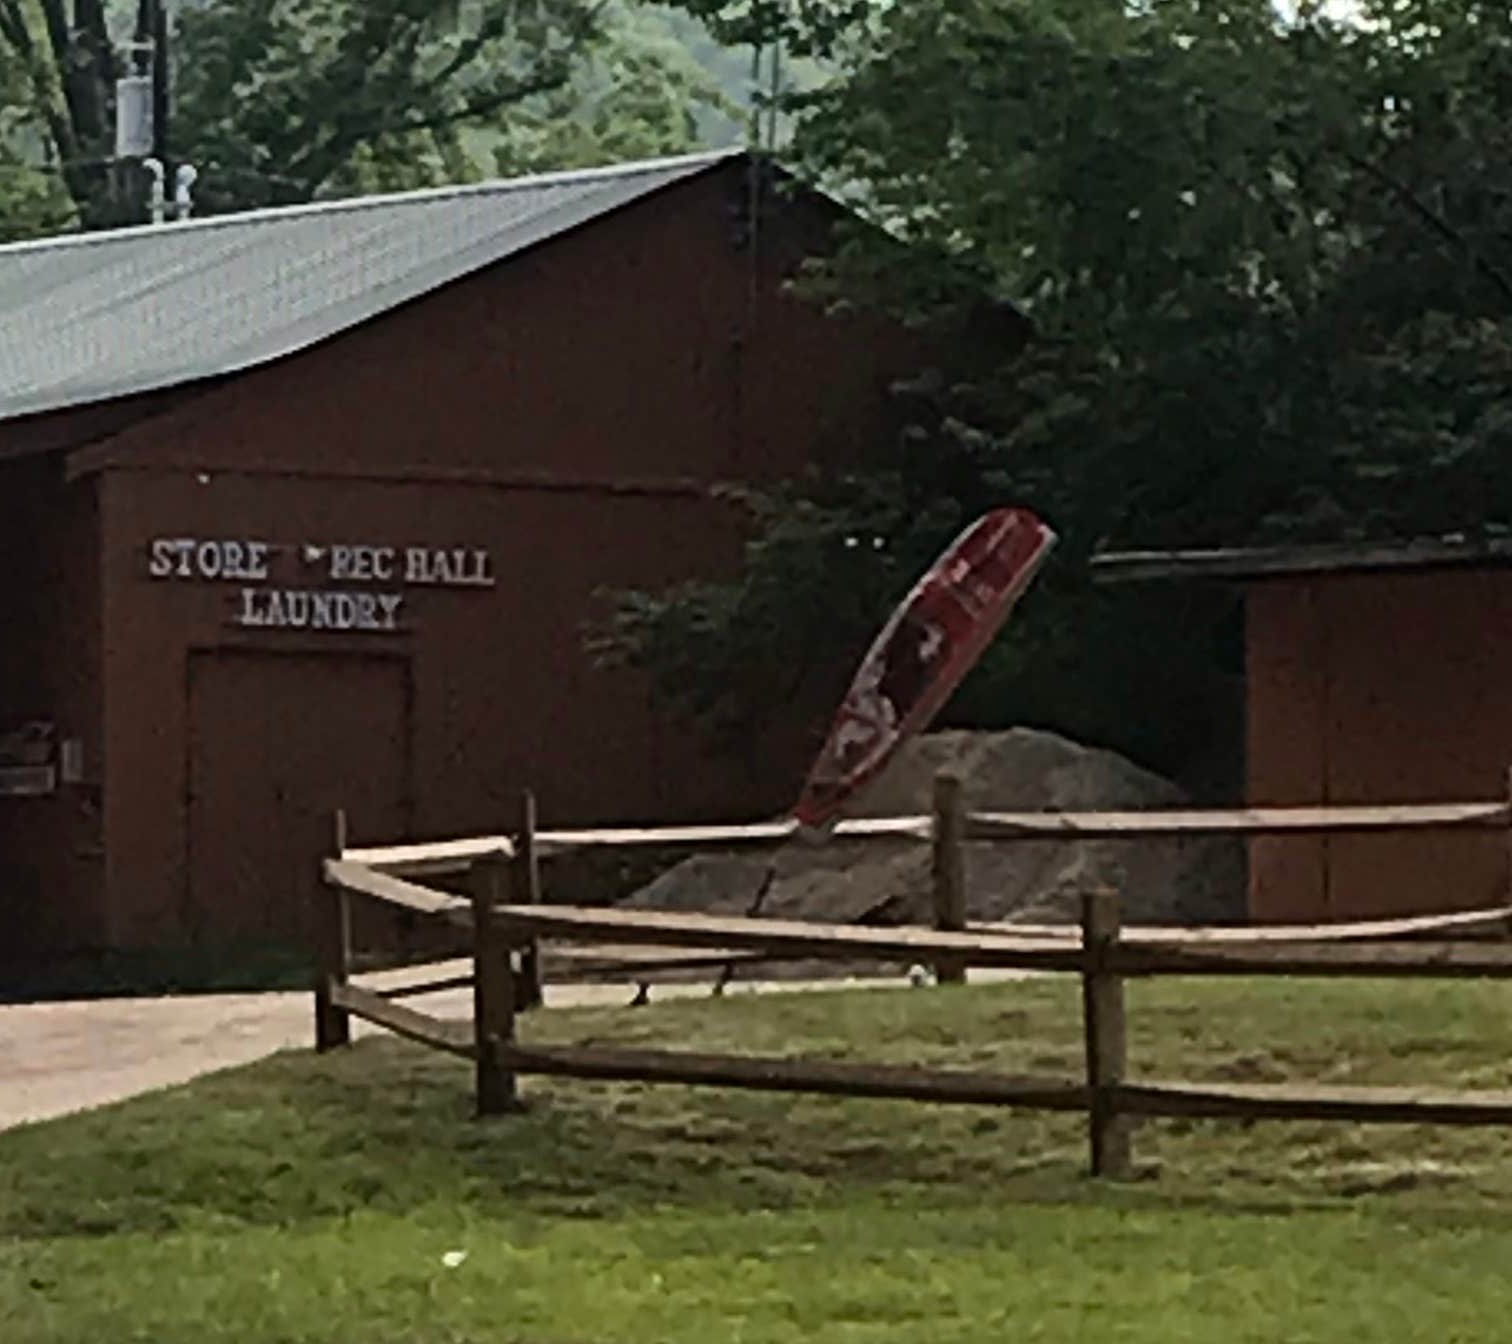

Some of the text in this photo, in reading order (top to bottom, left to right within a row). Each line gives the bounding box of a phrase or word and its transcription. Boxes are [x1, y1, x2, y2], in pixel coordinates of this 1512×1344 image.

[150, 539, 495, 586] STORE REC HALL
[240, 588, 403, 630] LAUNDRY
